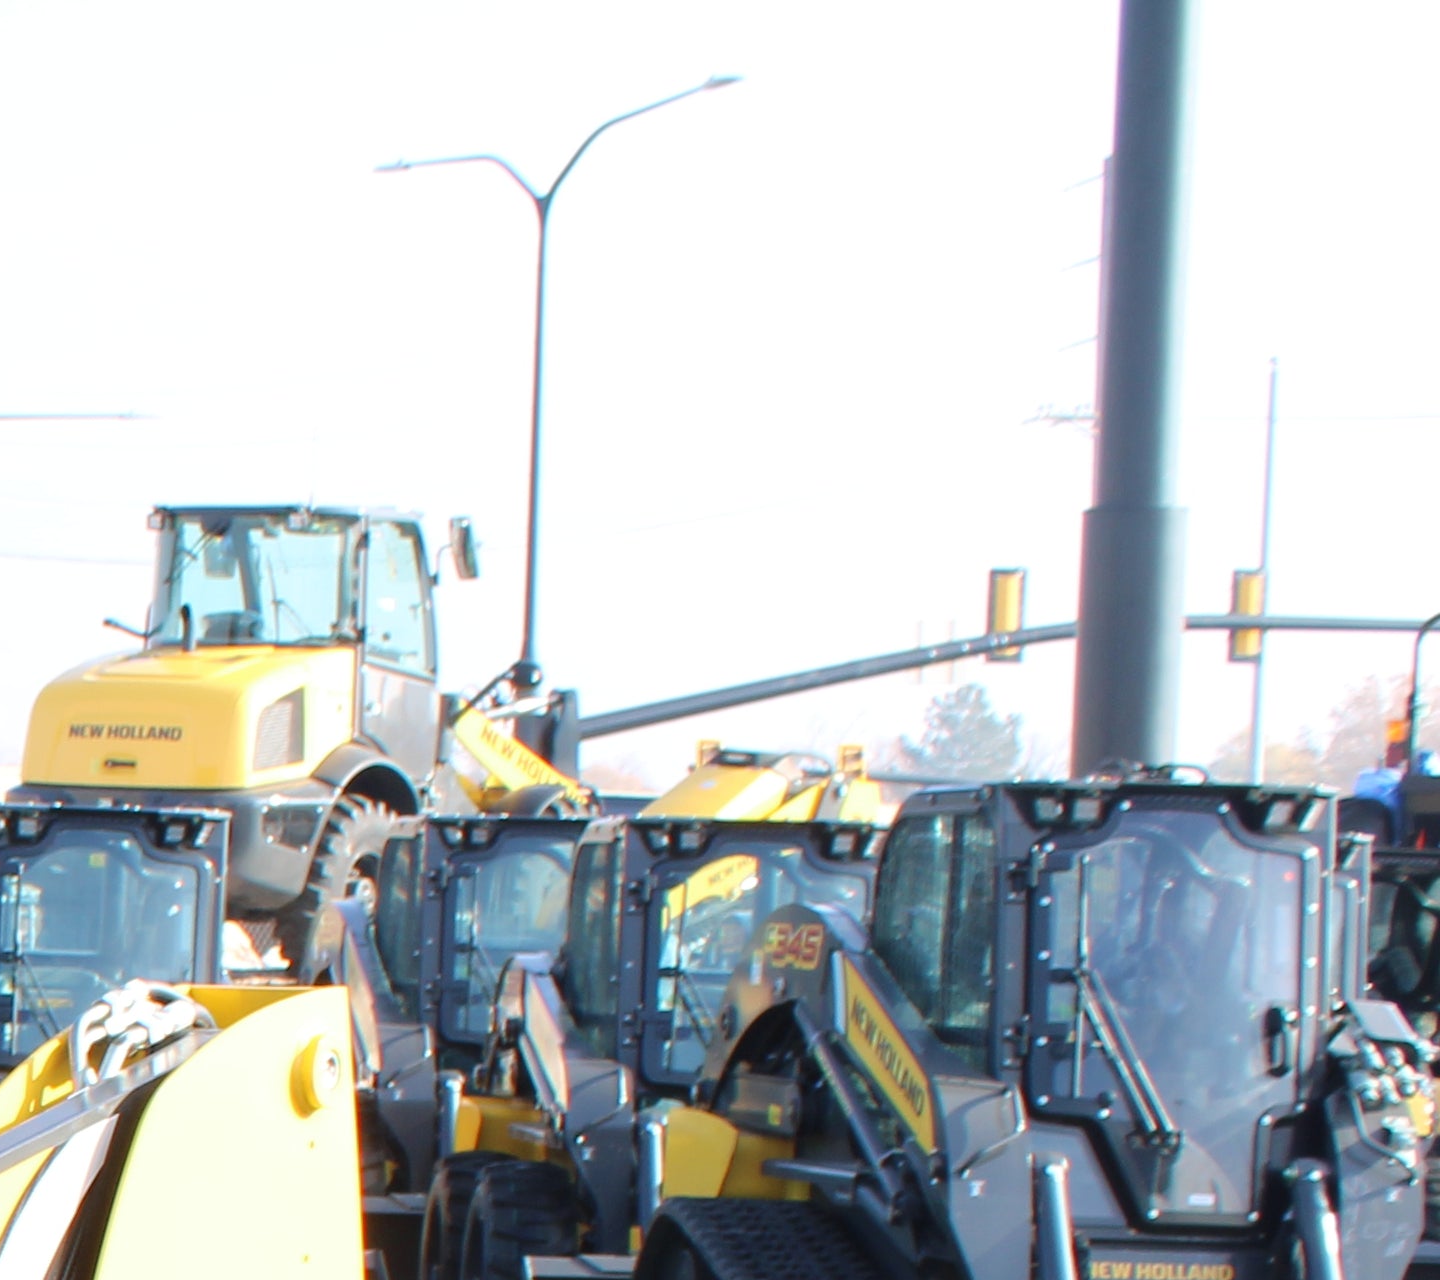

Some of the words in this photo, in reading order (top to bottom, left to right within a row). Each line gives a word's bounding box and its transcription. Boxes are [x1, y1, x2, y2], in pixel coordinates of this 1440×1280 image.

[68, 723, 104, 738] NEW
[107, 724, 183, 742] HOLLAND
[875, 1031, 926, 1117] HOLLAND
